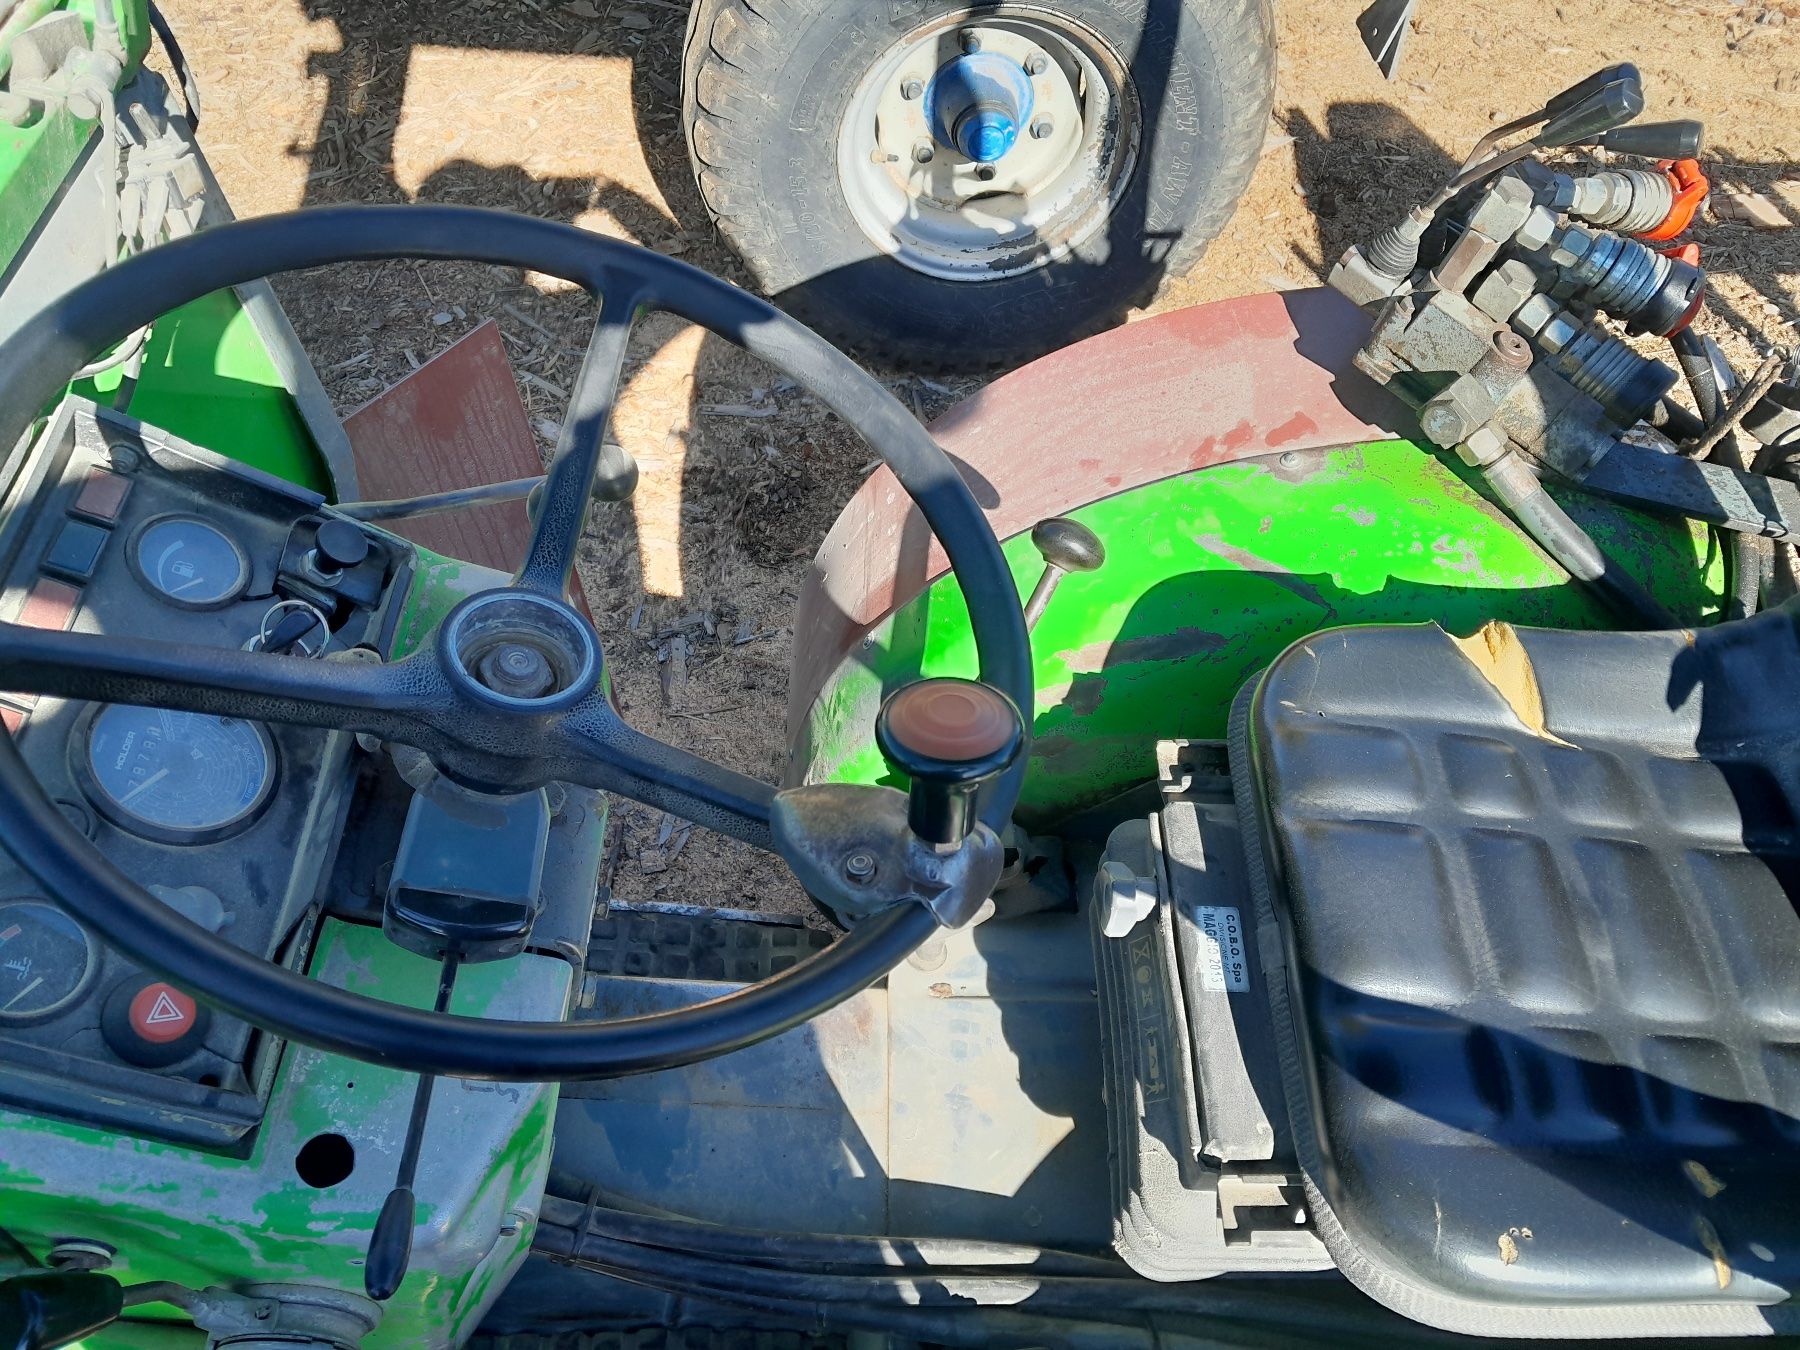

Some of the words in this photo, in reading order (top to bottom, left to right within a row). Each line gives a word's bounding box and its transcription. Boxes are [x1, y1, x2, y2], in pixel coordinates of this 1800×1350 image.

[114, 730, 136, 771] HOLDER
[1226, 914, 1240, 959] C.O.B.O.
[1232, 962, 1242, 983] Spa
